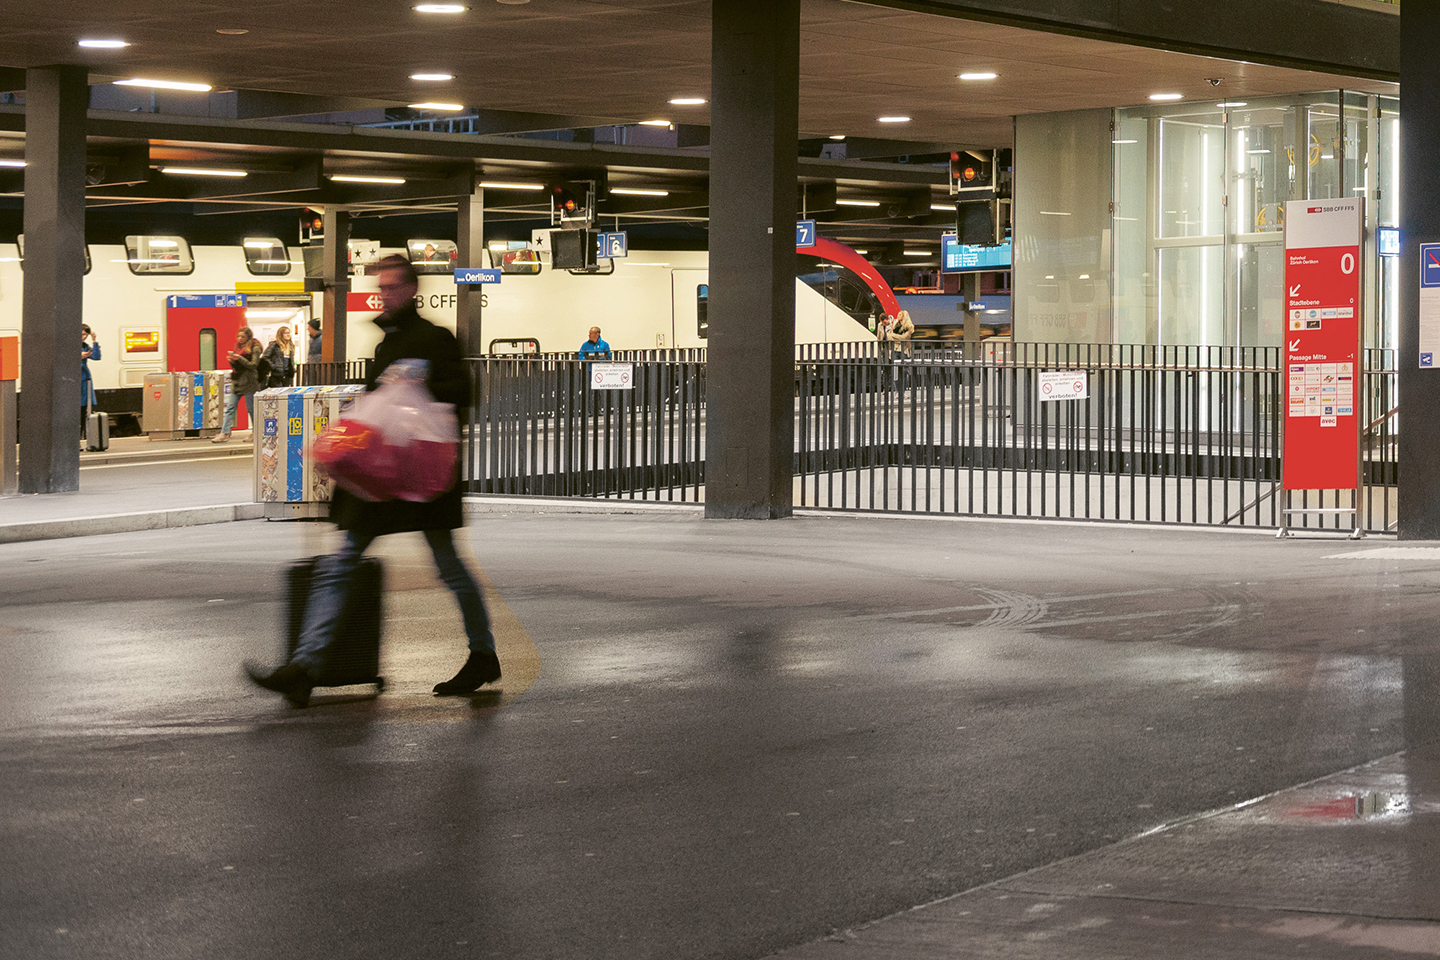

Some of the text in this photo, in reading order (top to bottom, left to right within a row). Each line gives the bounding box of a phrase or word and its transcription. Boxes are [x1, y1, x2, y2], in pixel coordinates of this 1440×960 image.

[800, 228, 808, 243] 7
[612, 240, 620, 254] 6
[1341, 253, 1354, 274] 0
[465, 273, 494, 282] Oerlikon
[170, 295, 177, 308] 1
[430, 294, 456, 308] CFF
